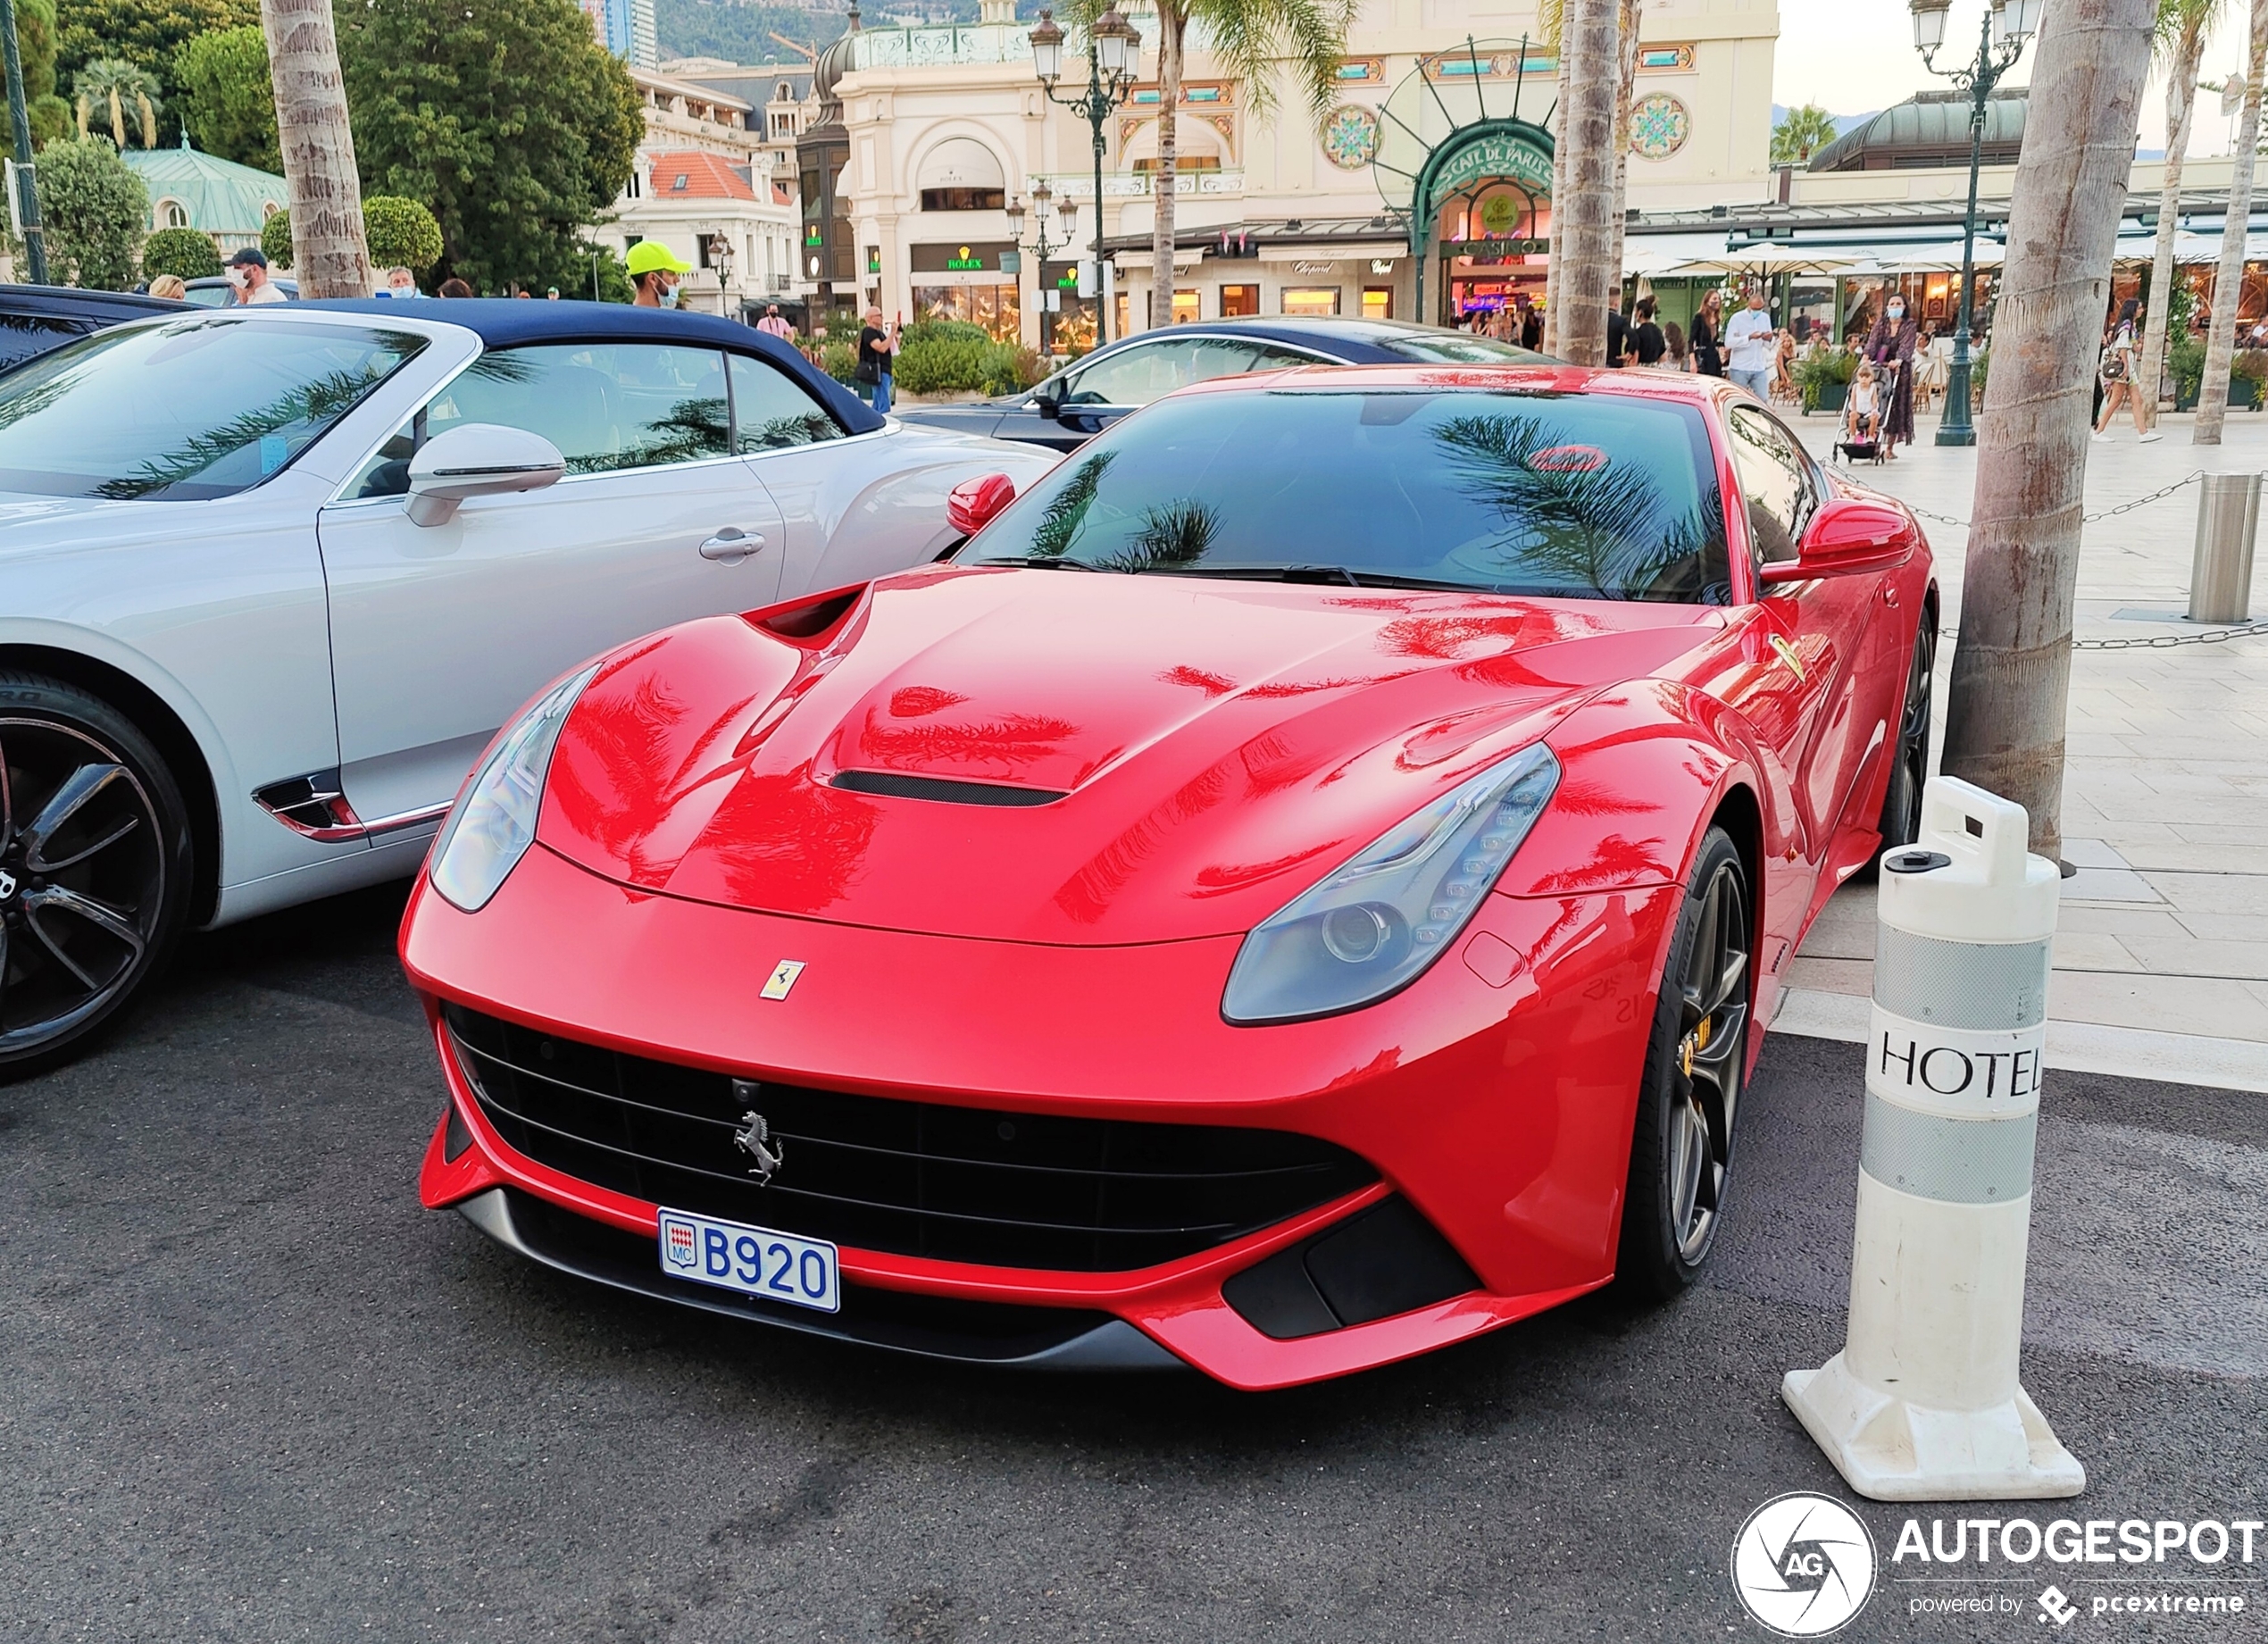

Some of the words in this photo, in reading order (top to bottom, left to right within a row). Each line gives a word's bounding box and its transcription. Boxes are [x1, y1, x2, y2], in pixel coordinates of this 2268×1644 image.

[1485, 147, 1502, 161] DE
[1506, 146, 1547, 173] PARIS
[1486, 215, 1513, 223] CASINO
[1464, 240, 1536, 258] CASINO
[947, 258, 982, 270] ROLEX
[1291, 260, 1334, 277] Chopard
[673, 1246, 692, 1261] MC
[705, 1228, 827, 1298] B920
